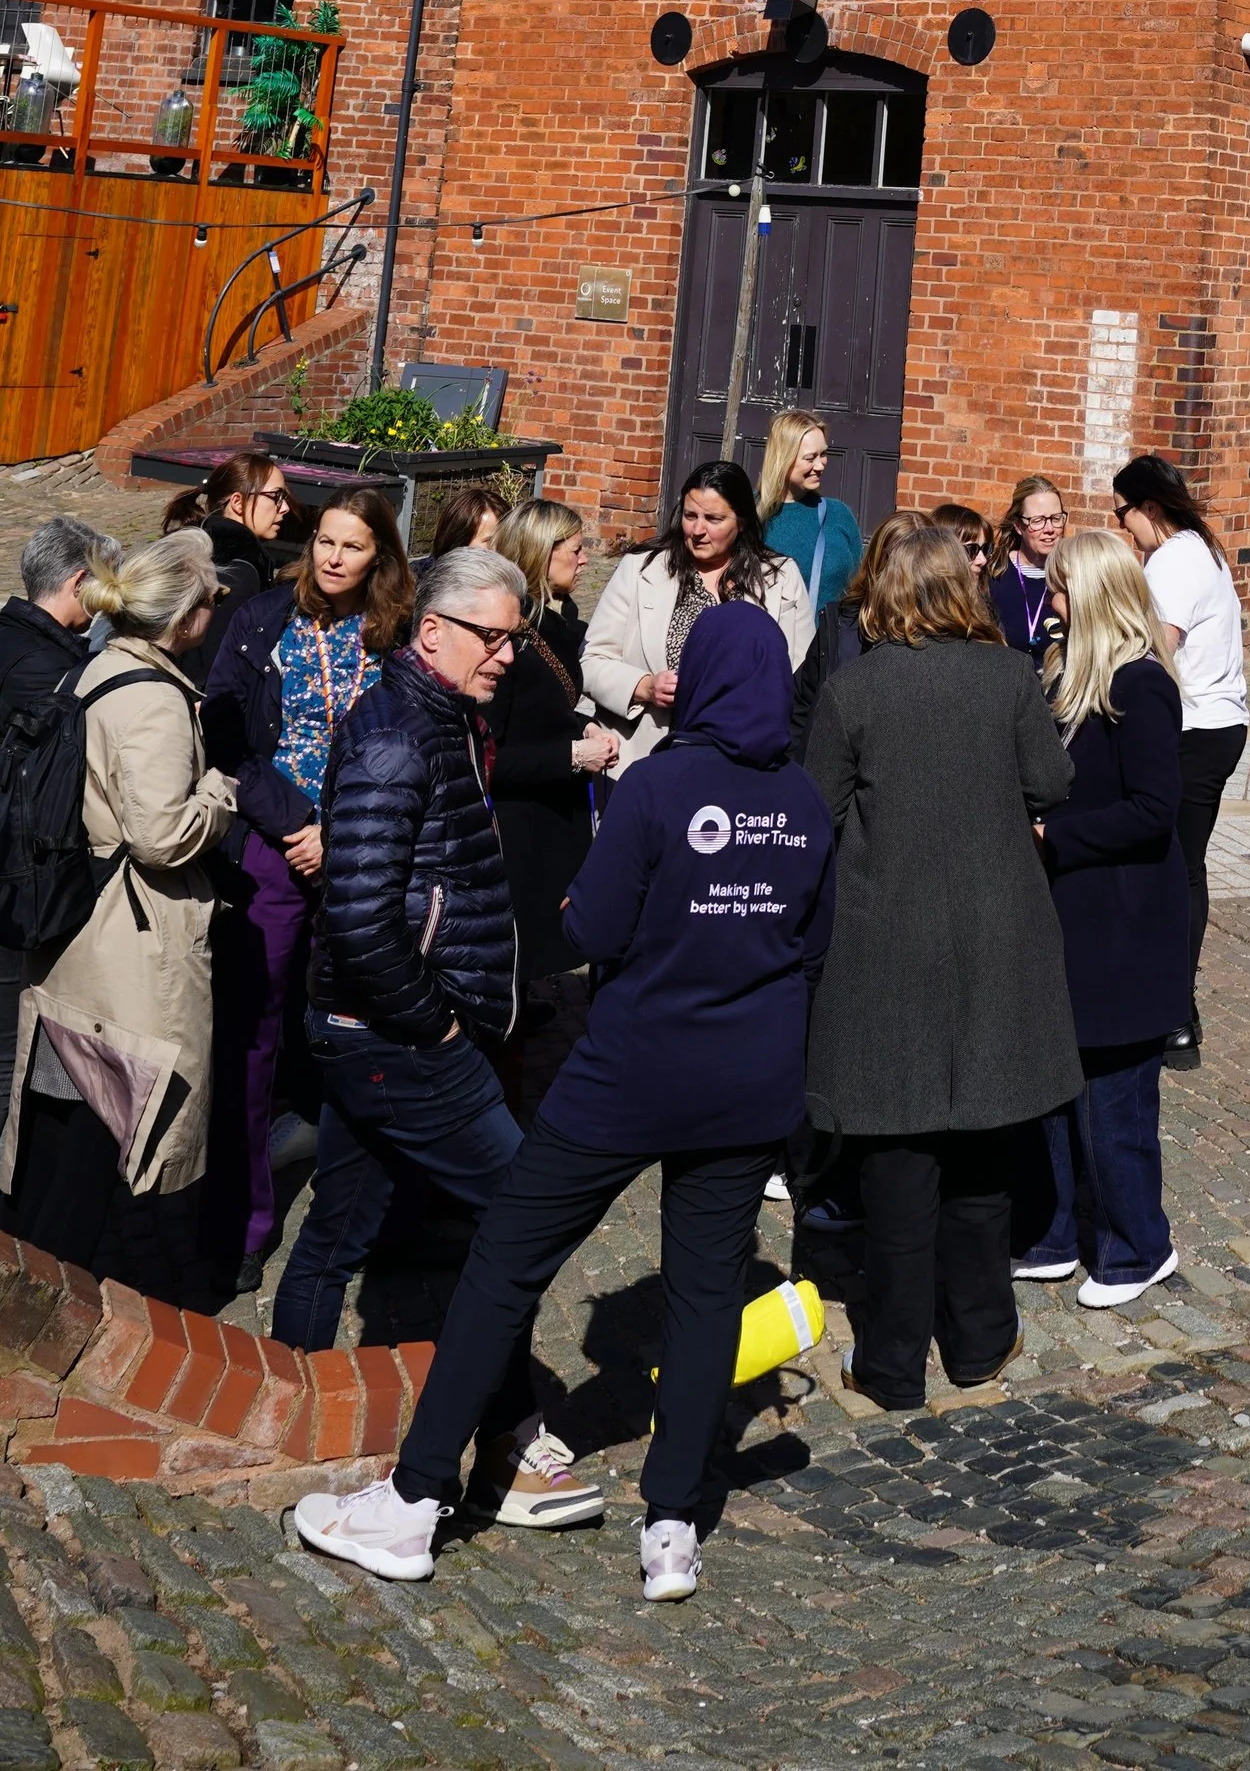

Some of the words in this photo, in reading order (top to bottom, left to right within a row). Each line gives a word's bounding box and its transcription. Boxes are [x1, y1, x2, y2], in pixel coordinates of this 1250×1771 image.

[602, 285, 622, 295] Event
[600, 295, 621, 305] Space
[735, 813, 774, 828] Canal
[776, 813, 788, 828] &
[735, 830, 769, 845] River
[771, 830, 807, 848] Trust
[709, 883, 750, 899] Making
[754, 882, 773, 896] life
[690, 900, 731, 914] better
[733, 901, 747, 916] by
[749, 901, 787, 914] water
